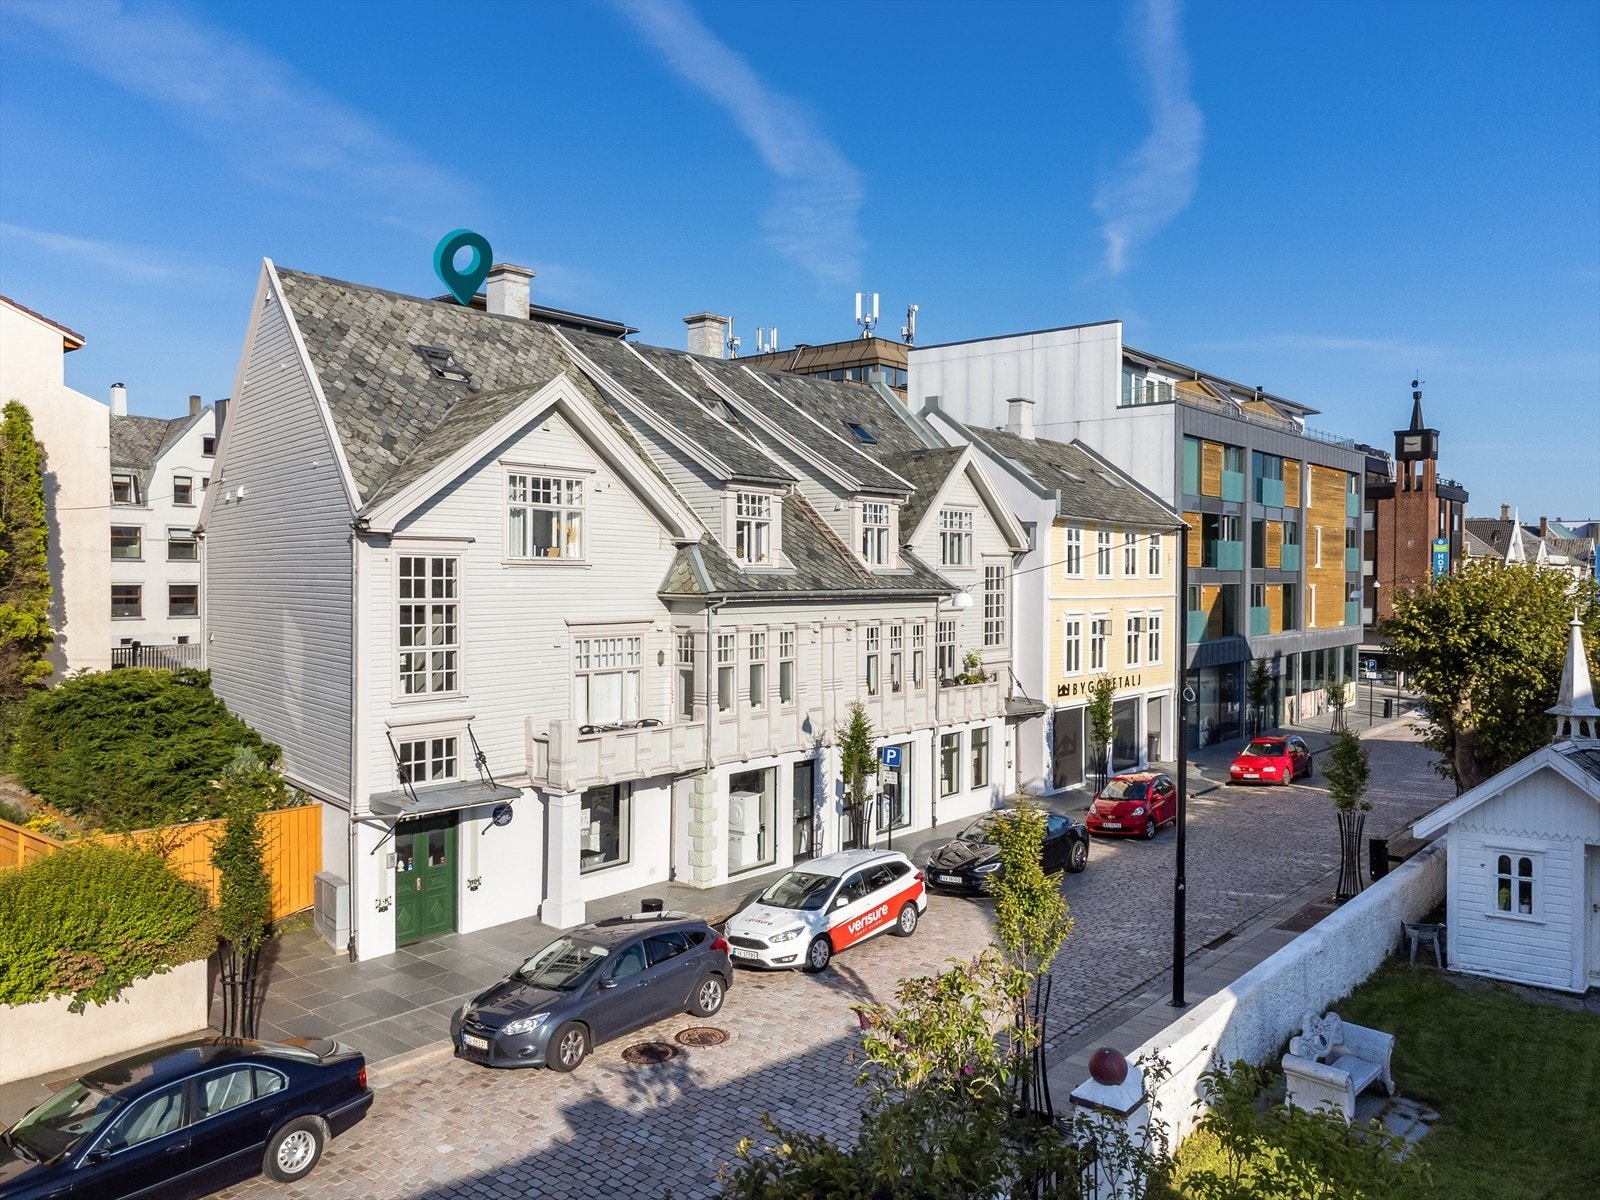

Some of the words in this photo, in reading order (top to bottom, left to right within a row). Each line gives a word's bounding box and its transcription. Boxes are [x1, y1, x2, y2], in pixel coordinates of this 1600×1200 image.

[1437, 553, 1445, 576] HOT
[1369, 661, 1376, 669] P
[886, 749, 897, 764] P
[848, 904, 889, 935] verisure
